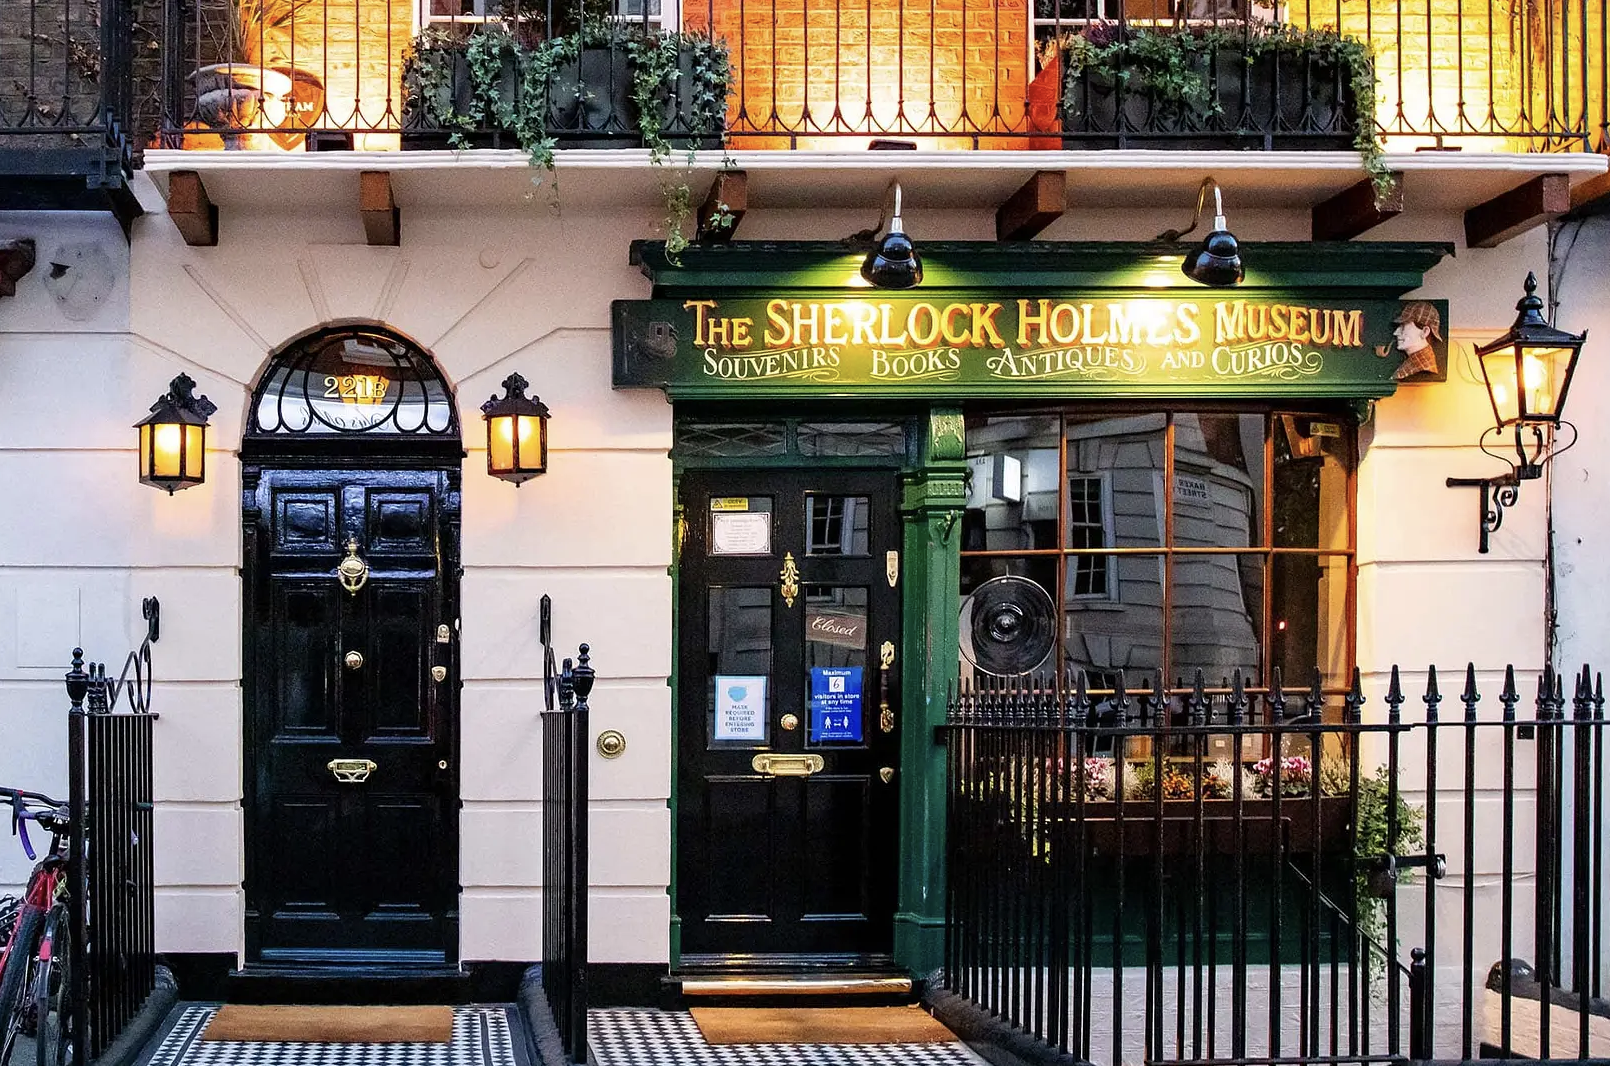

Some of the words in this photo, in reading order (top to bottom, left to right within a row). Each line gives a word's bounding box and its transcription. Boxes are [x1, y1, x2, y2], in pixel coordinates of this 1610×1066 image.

[764, 298, 1005, 348] SHERLOCK
[1016, 298, 1201, 347] HOLMES
[1213, 299, 1363, 348] MUSEUM
[703, 347, 840, 379] SOUVENIRS
[869, 347, 961, 377] BOOKS
[986, 346, 1138, 377] ANTIQUES
[1160, 351, 1206, 370] AND
[1211, 342, 1303, 376] CURIOS
[323, 375, 387, 399] 221B
[811, 616, 857, 637] Closed
[832, 678, 841, 690] 6
